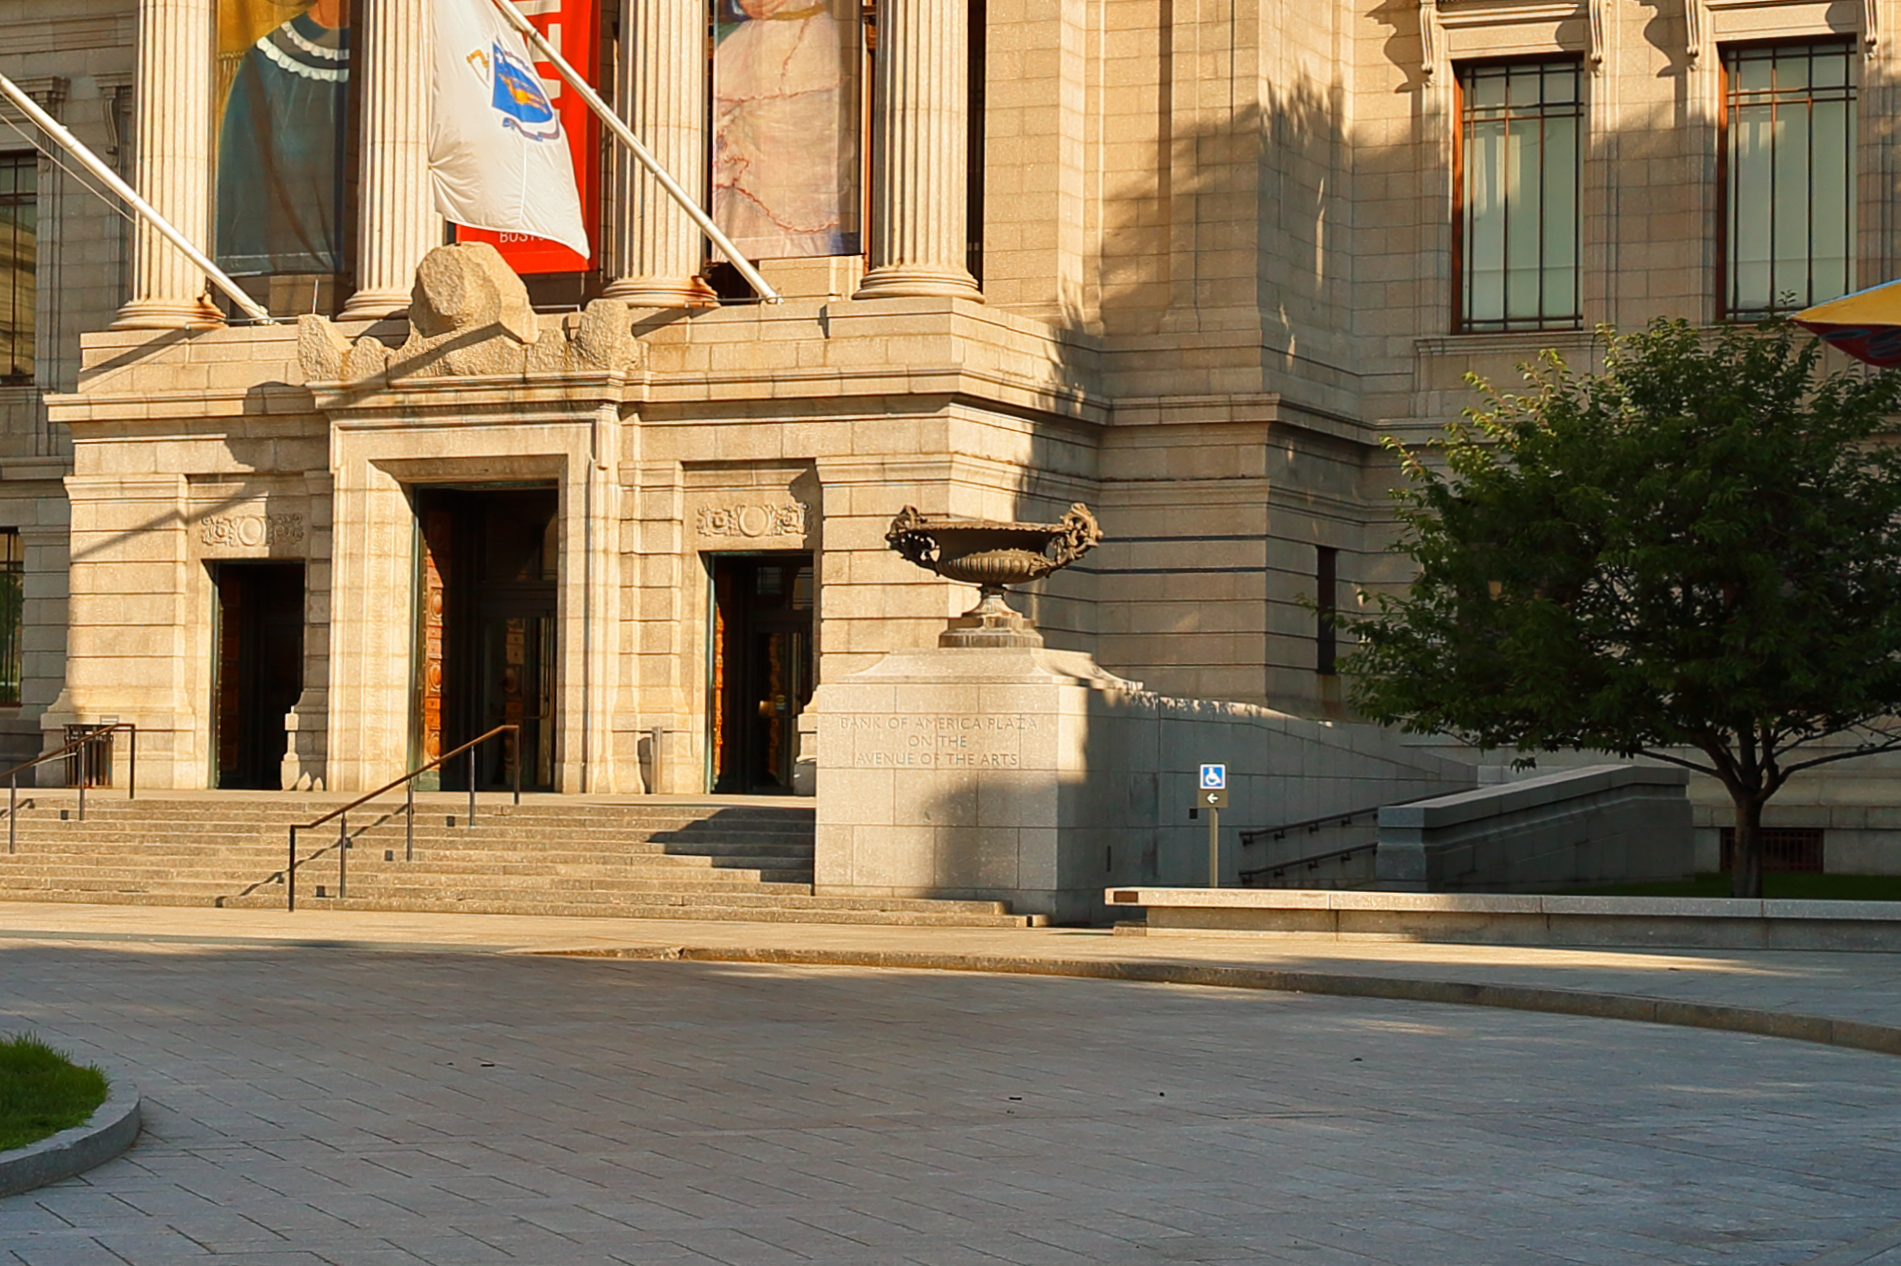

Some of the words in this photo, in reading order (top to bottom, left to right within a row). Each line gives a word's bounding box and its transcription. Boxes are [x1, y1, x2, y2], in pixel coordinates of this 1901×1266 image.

[840, 717, 882, 730] BANK
[887, 717, 908, 730] OF
[914, 717, 982, 731] AMERICA
[986, 717, 1038, 731] PLAZA
[907, 735, 932, 748] ON
[938, 735, 967, 748] THE
[855, 752, 914, 766] AVENUE
[919, 752, 940, 765] OF
[947, 753, 975, 766] THE
[980, 753, 1018, 766] ARTS
